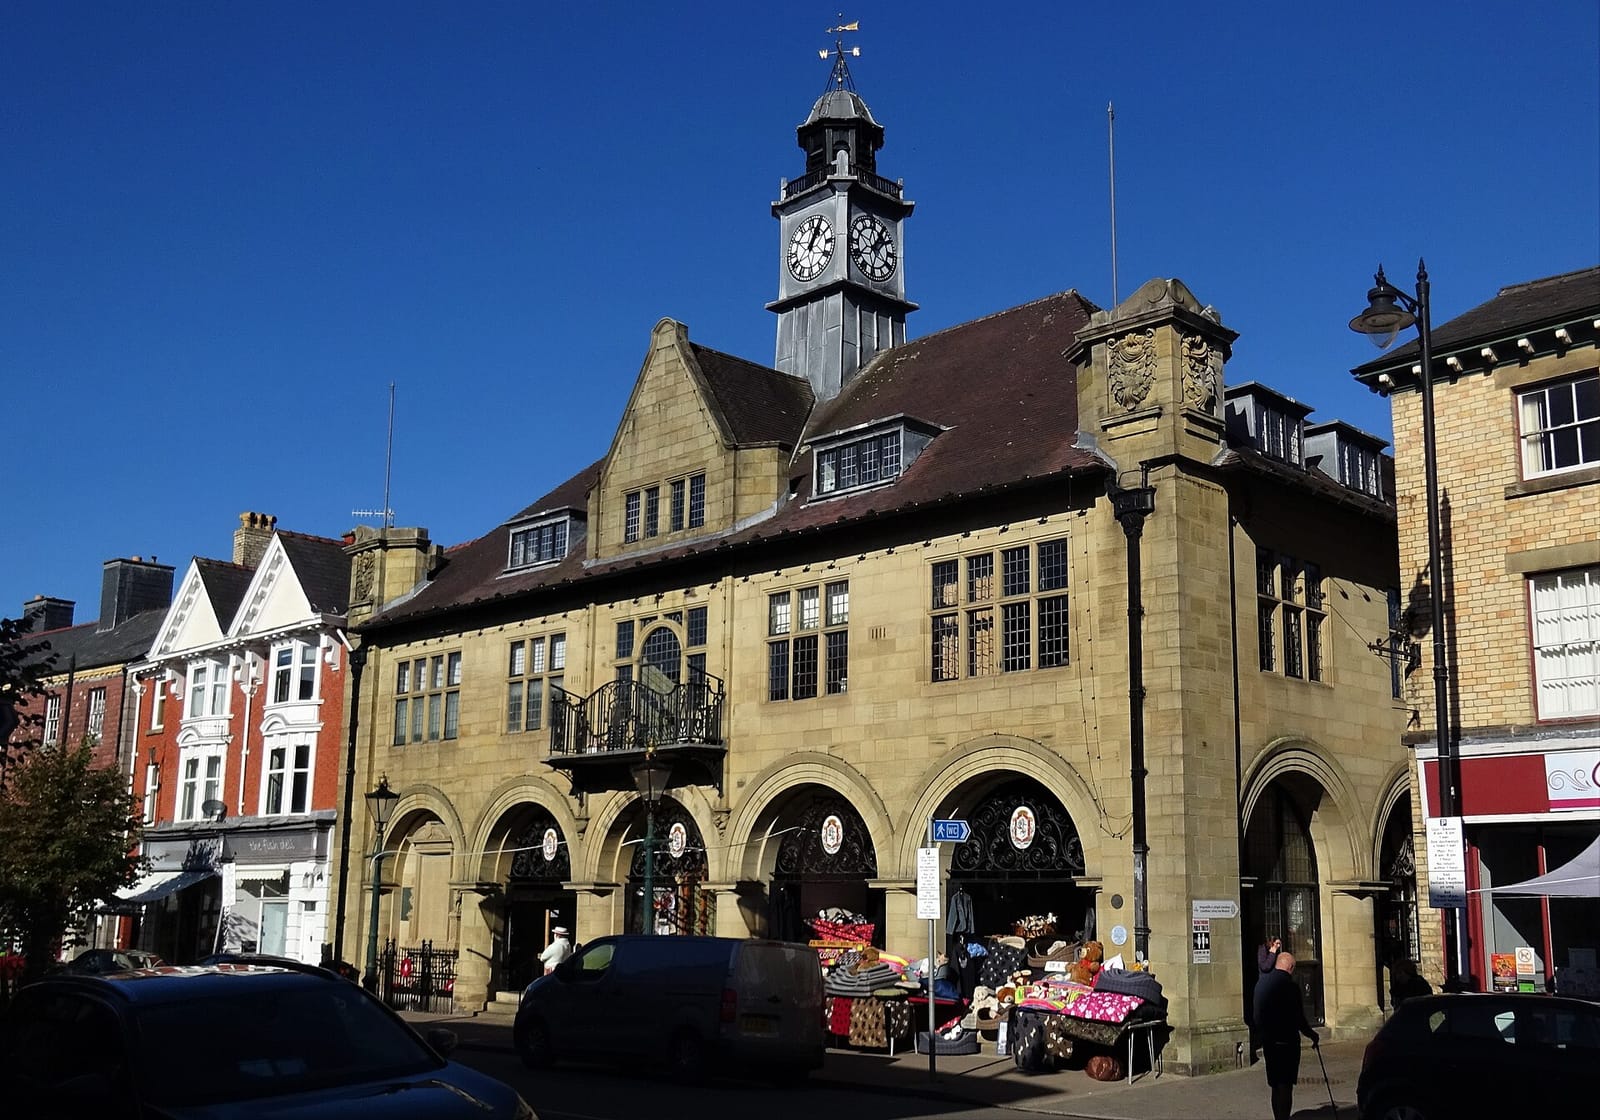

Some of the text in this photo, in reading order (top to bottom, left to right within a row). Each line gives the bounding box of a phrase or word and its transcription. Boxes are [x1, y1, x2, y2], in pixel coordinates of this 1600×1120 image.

[819, 49, 828, 59] W
[948, 826, 958, 835] WC
[249, 841, 262, 851] the
